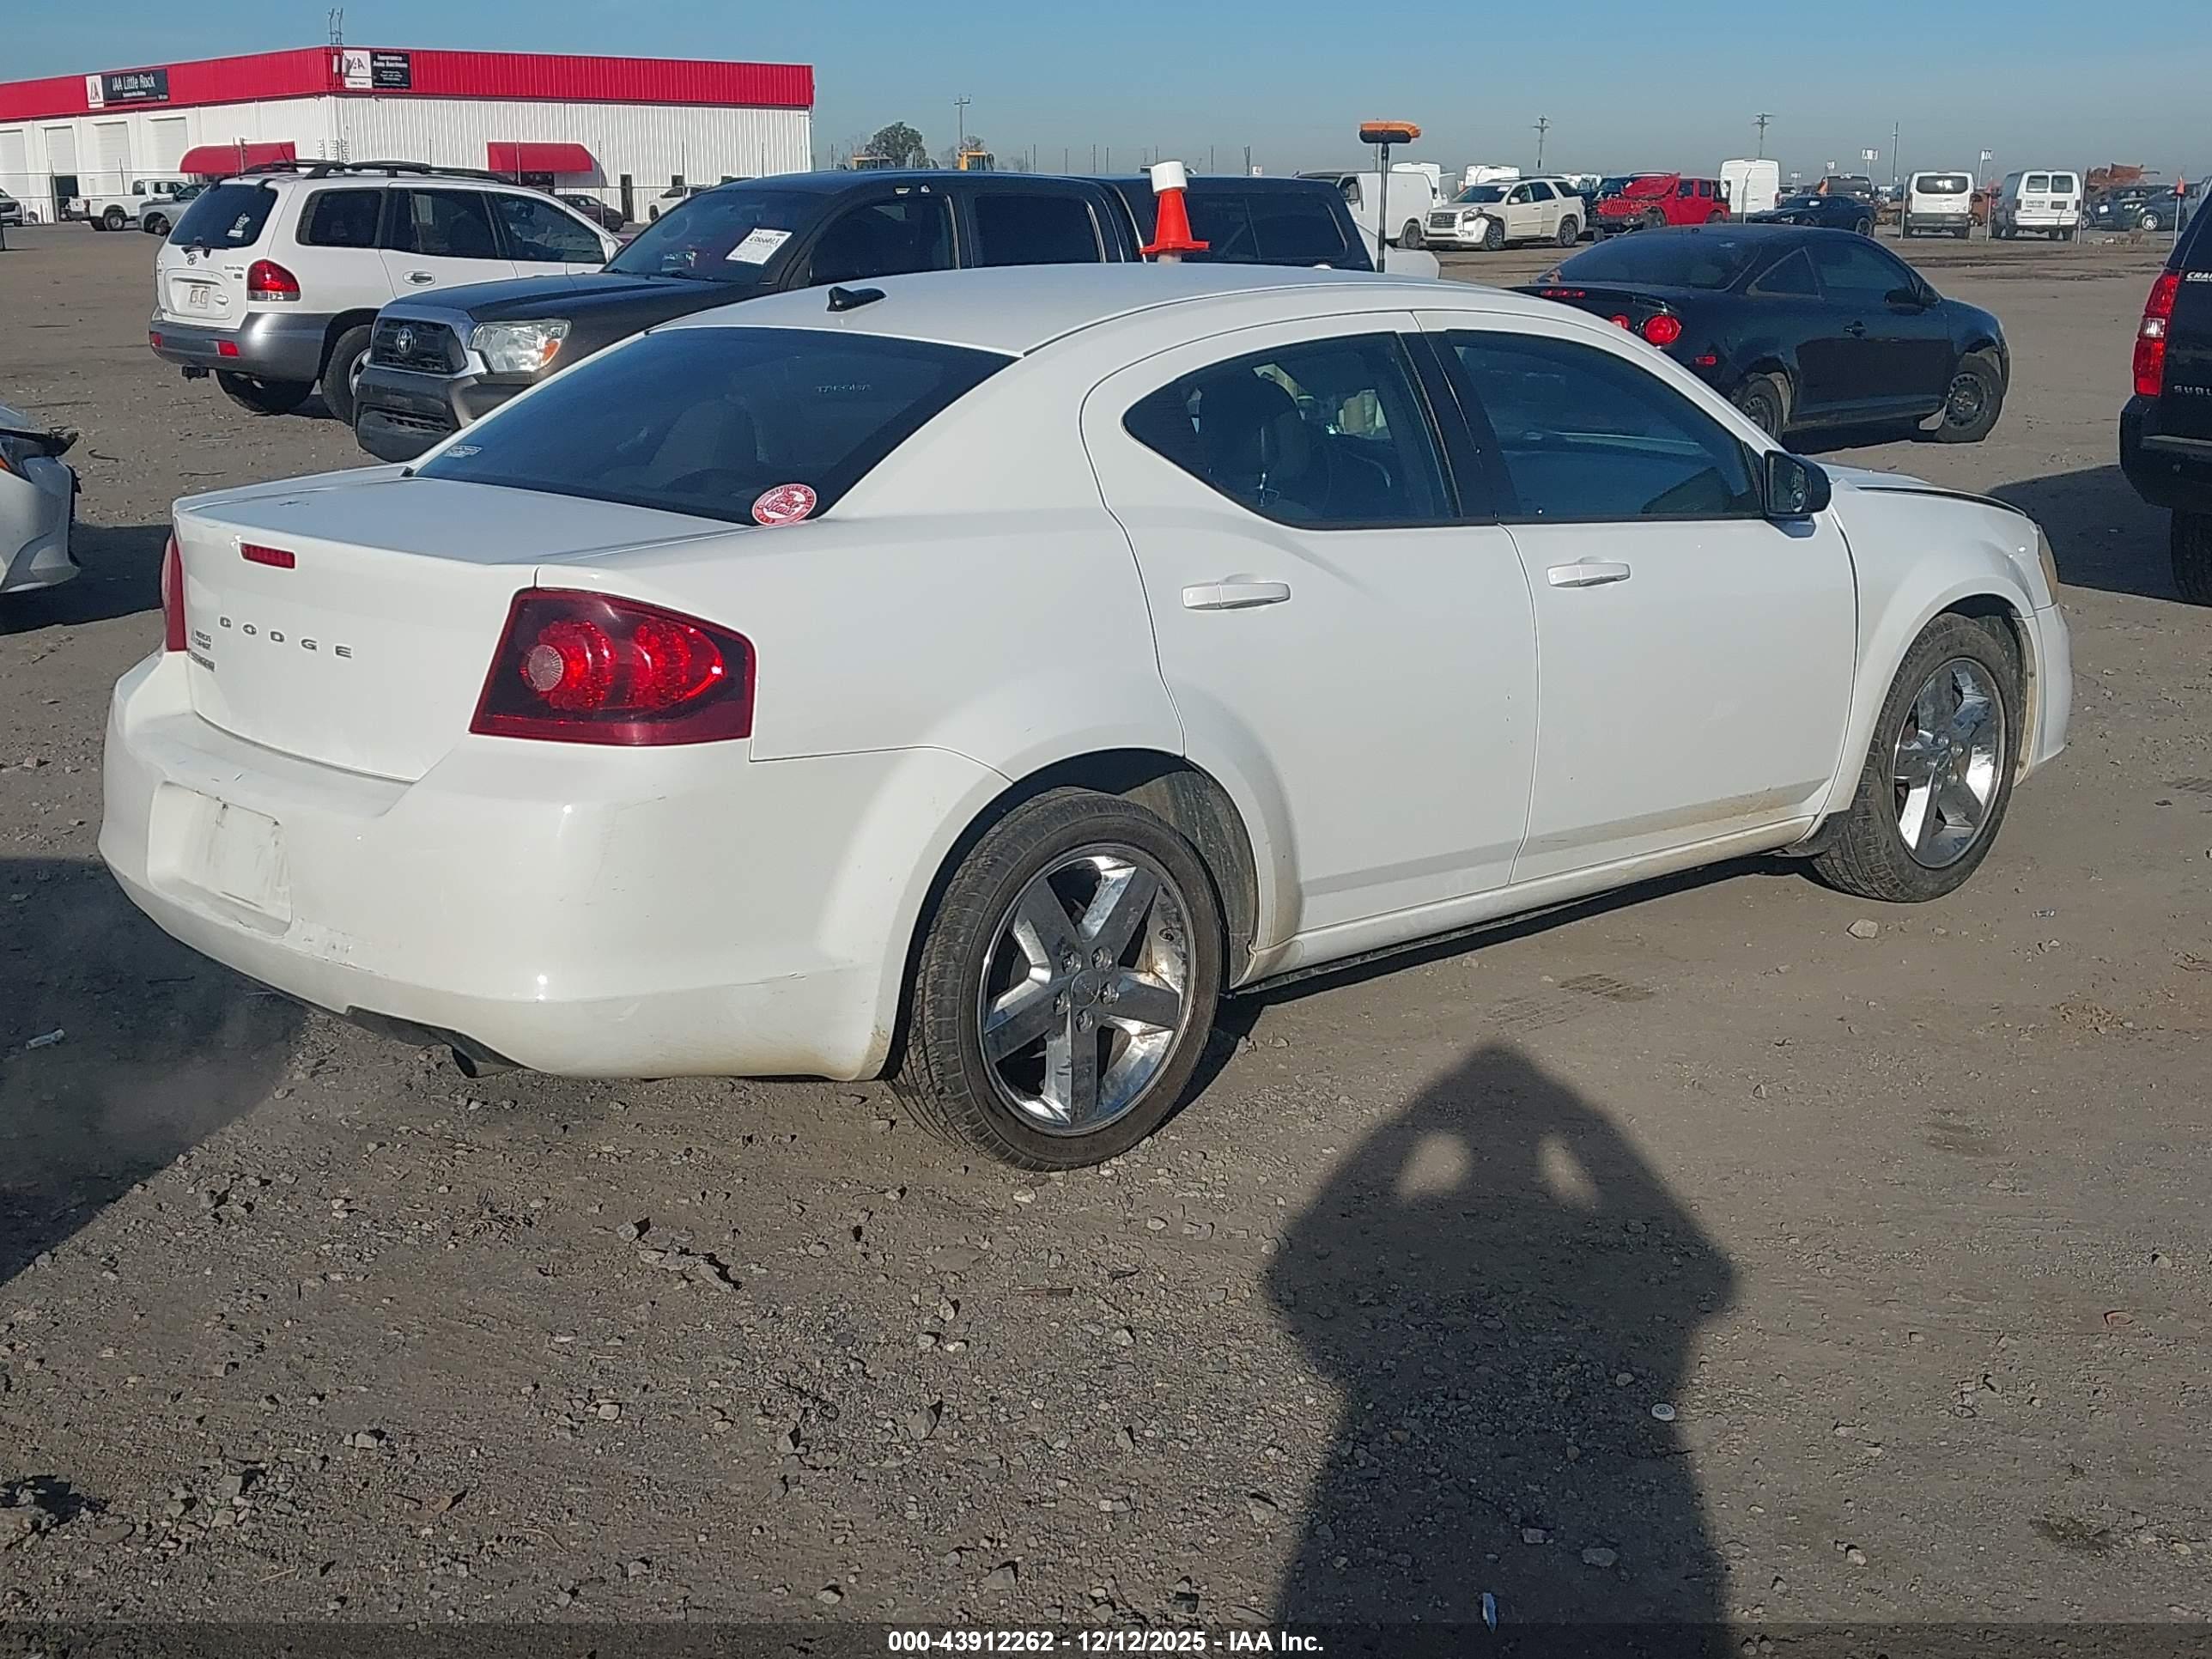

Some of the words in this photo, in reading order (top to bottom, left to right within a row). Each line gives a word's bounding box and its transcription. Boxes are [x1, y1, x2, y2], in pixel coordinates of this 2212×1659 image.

[112, 76, 123, 92] IAA
[123, 75, 138, 90] Little
[139, 72, 156, 88] Rock
[219, 617, 352, 659] DODGE
